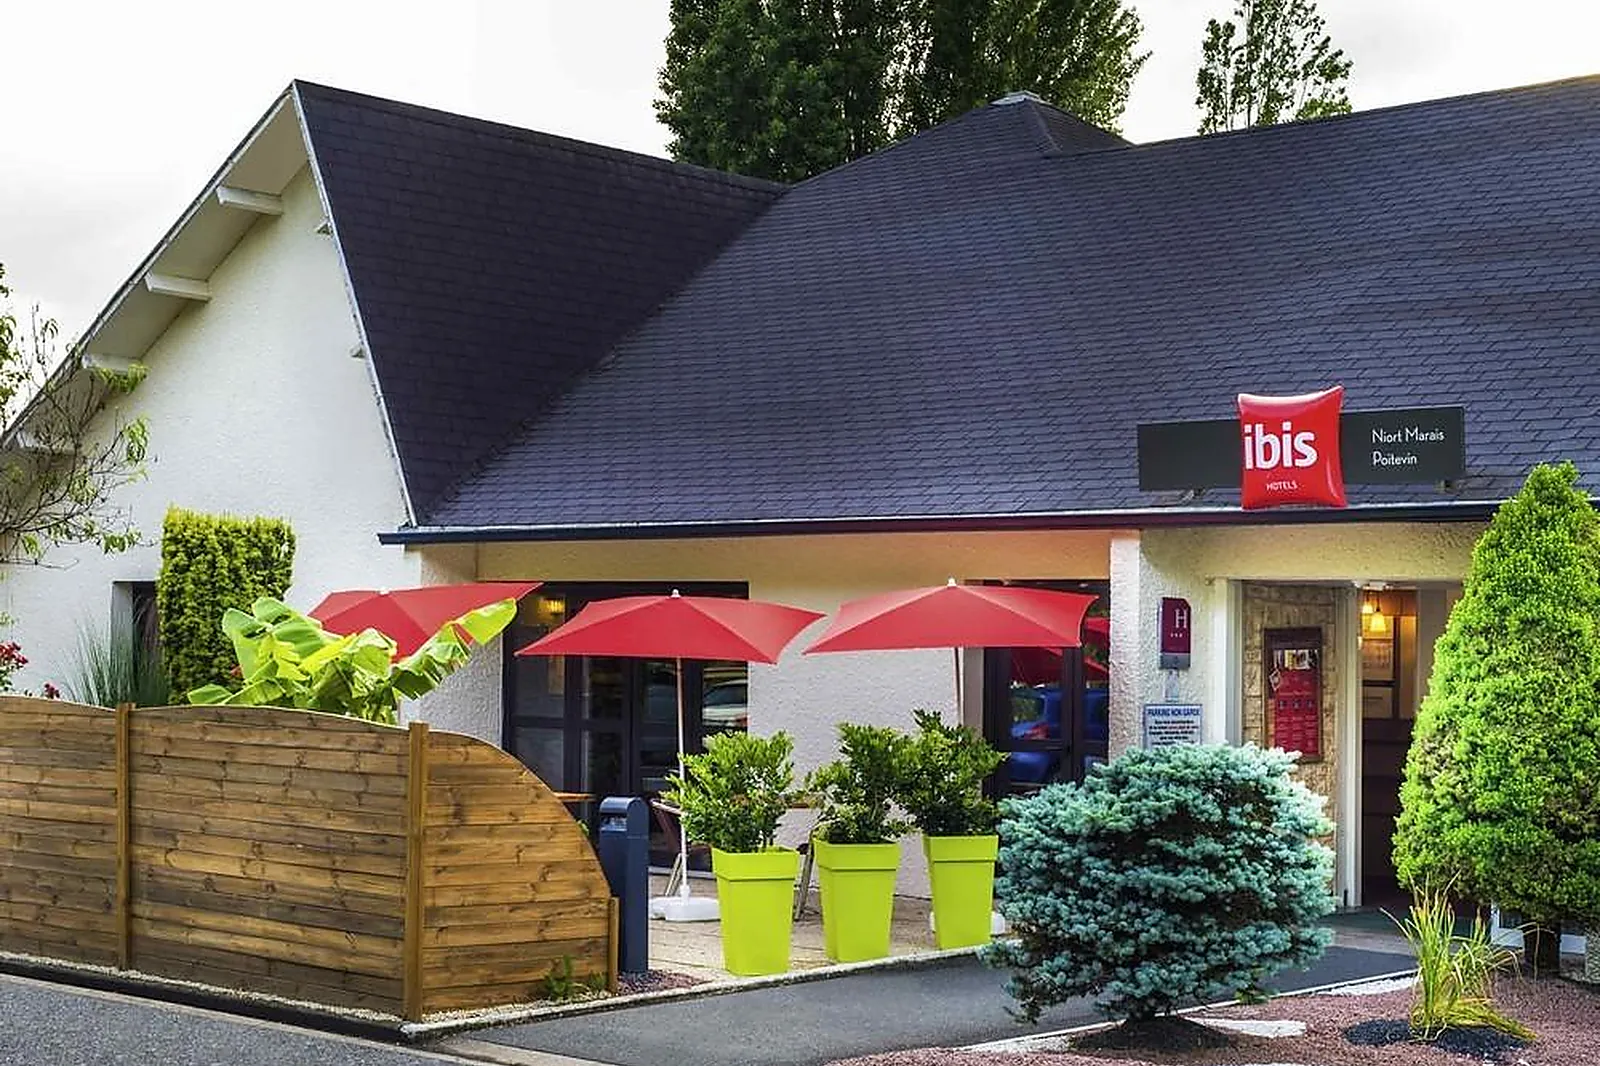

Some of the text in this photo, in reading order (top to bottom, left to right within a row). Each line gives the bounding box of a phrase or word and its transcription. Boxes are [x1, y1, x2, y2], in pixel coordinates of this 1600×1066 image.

[1372, 426, 1445, 443] Niort Marais
[1243, 421, 1318, 470] ibis
[1373, 450, 1418, 466] Poitevin
[1266, 480, 1298, 491] HOTELS
[1175, 608, 1187, 629] H
